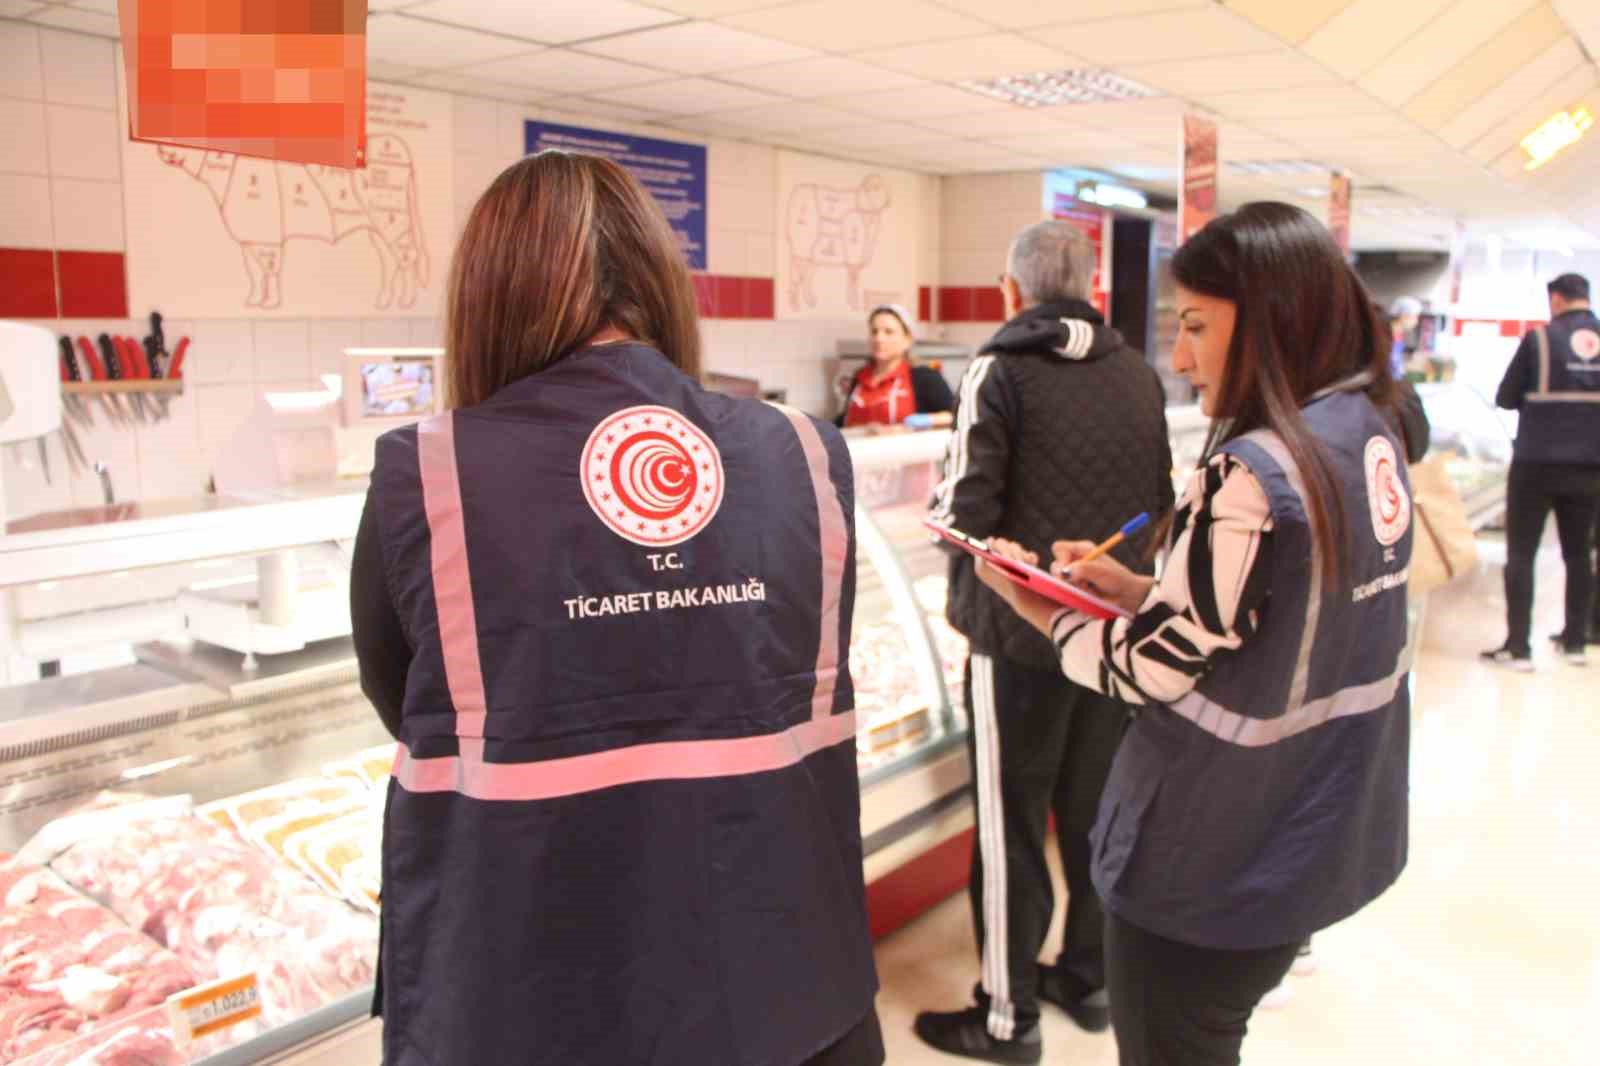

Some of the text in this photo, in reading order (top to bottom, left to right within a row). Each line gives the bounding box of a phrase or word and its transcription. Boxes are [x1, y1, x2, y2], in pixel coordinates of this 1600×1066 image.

[647, 552, 684, 571] T.C.
[564, 578, 766, 619] TİCARET BAKANLIĞI
